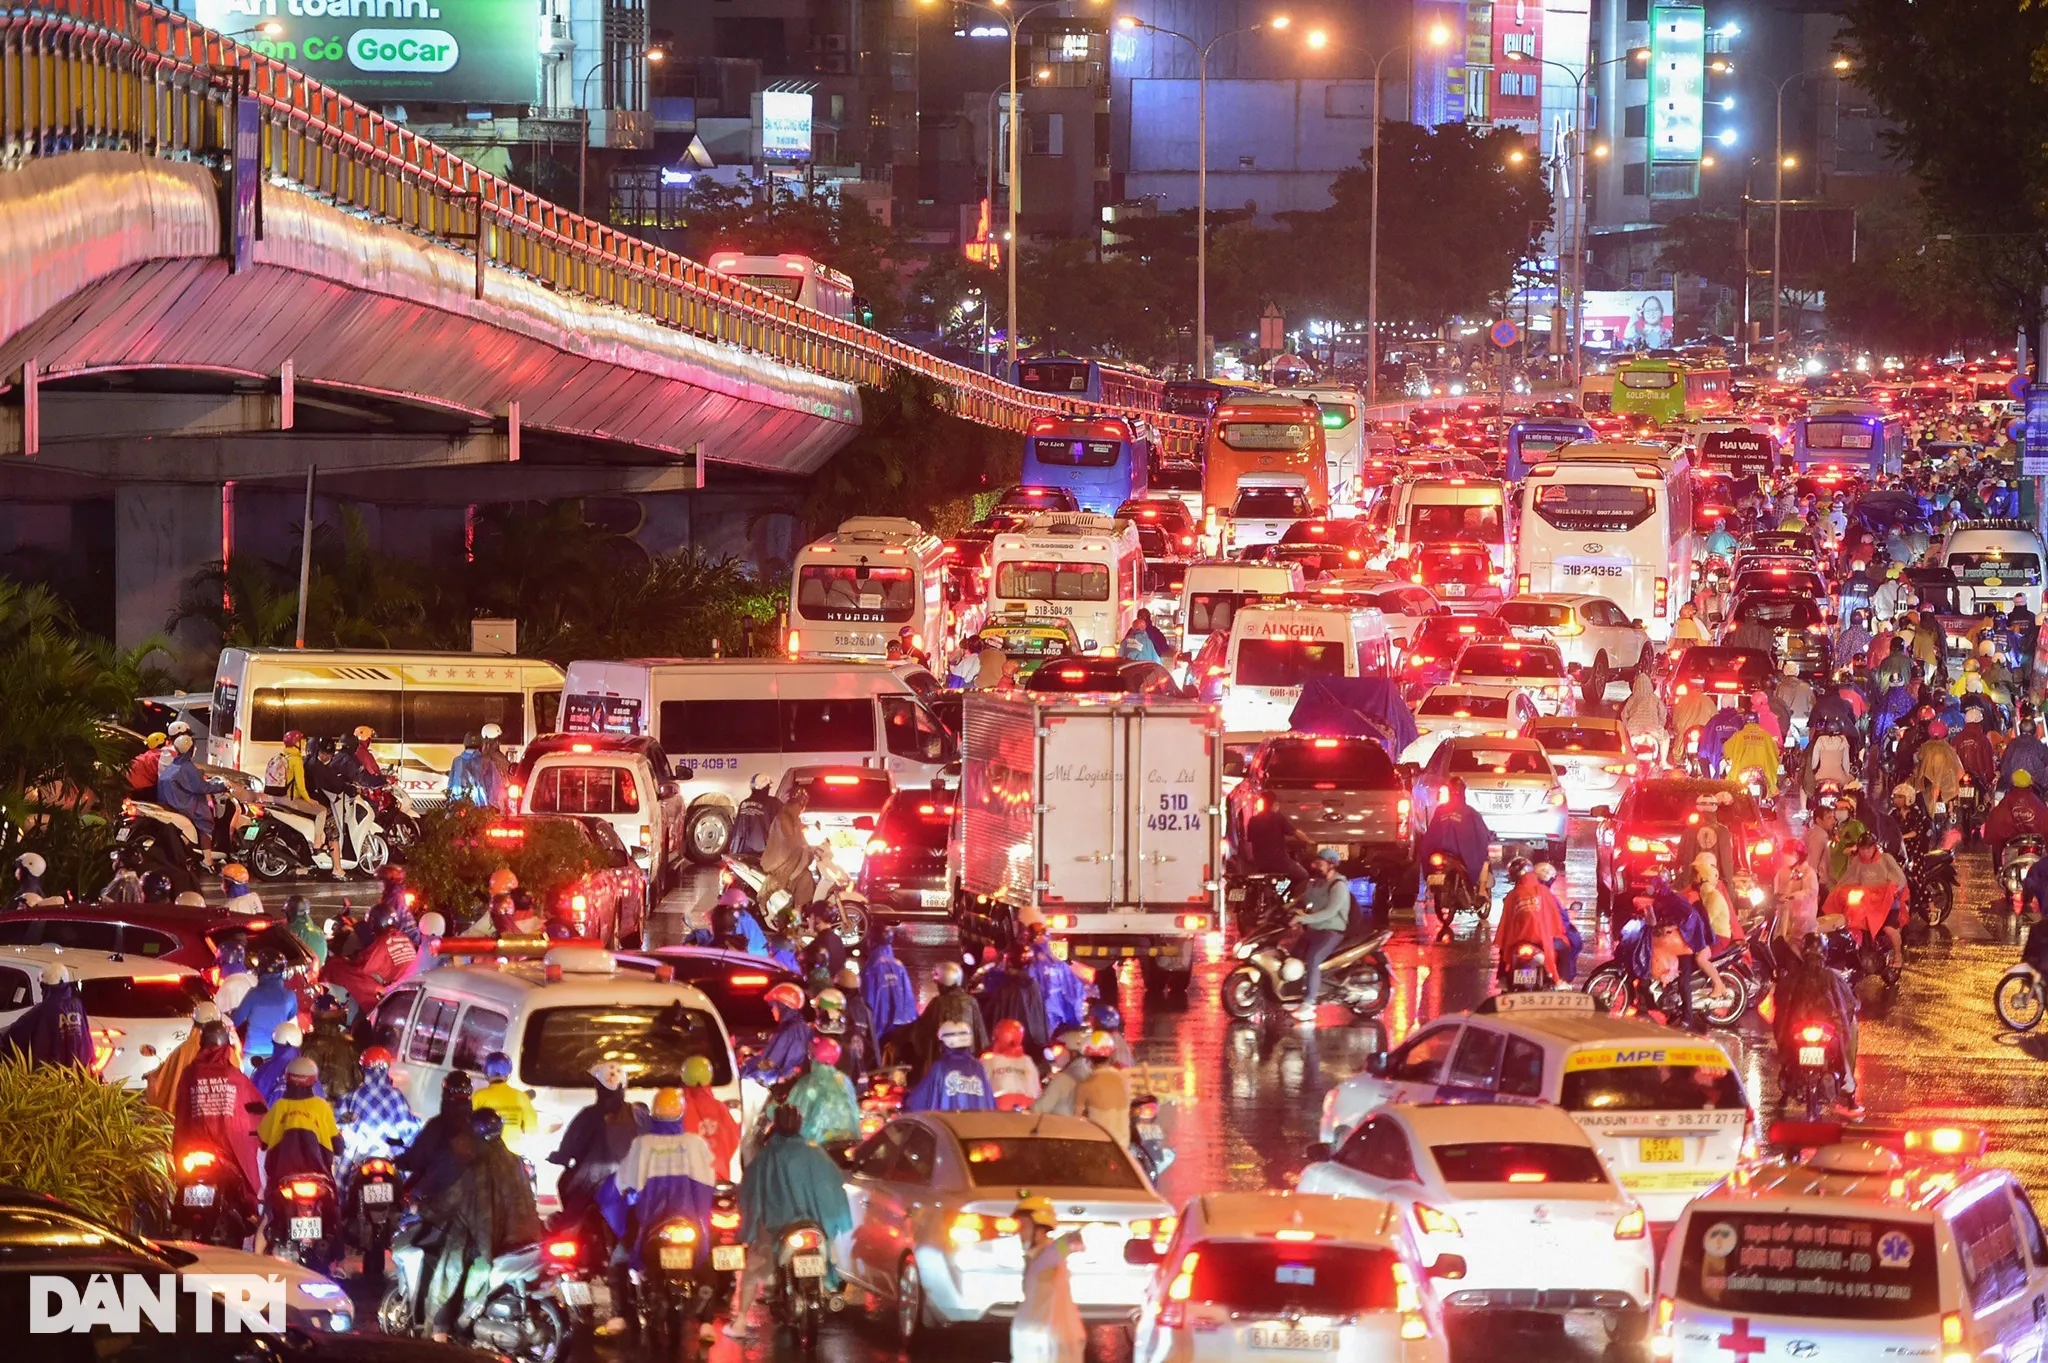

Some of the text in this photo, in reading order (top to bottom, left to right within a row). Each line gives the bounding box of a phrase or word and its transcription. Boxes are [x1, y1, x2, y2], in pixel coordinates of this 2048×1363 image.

[302, 36, 343, 61] Có
[357, 38, 449, 62] GoCar
[827, 612, 885, 622] HYUNDAI
[1159, 793, 1189, 811] 51D
[1146, 814, 1202, 831] 492.14
[1616, 1050, 1666, 1064] MPE
